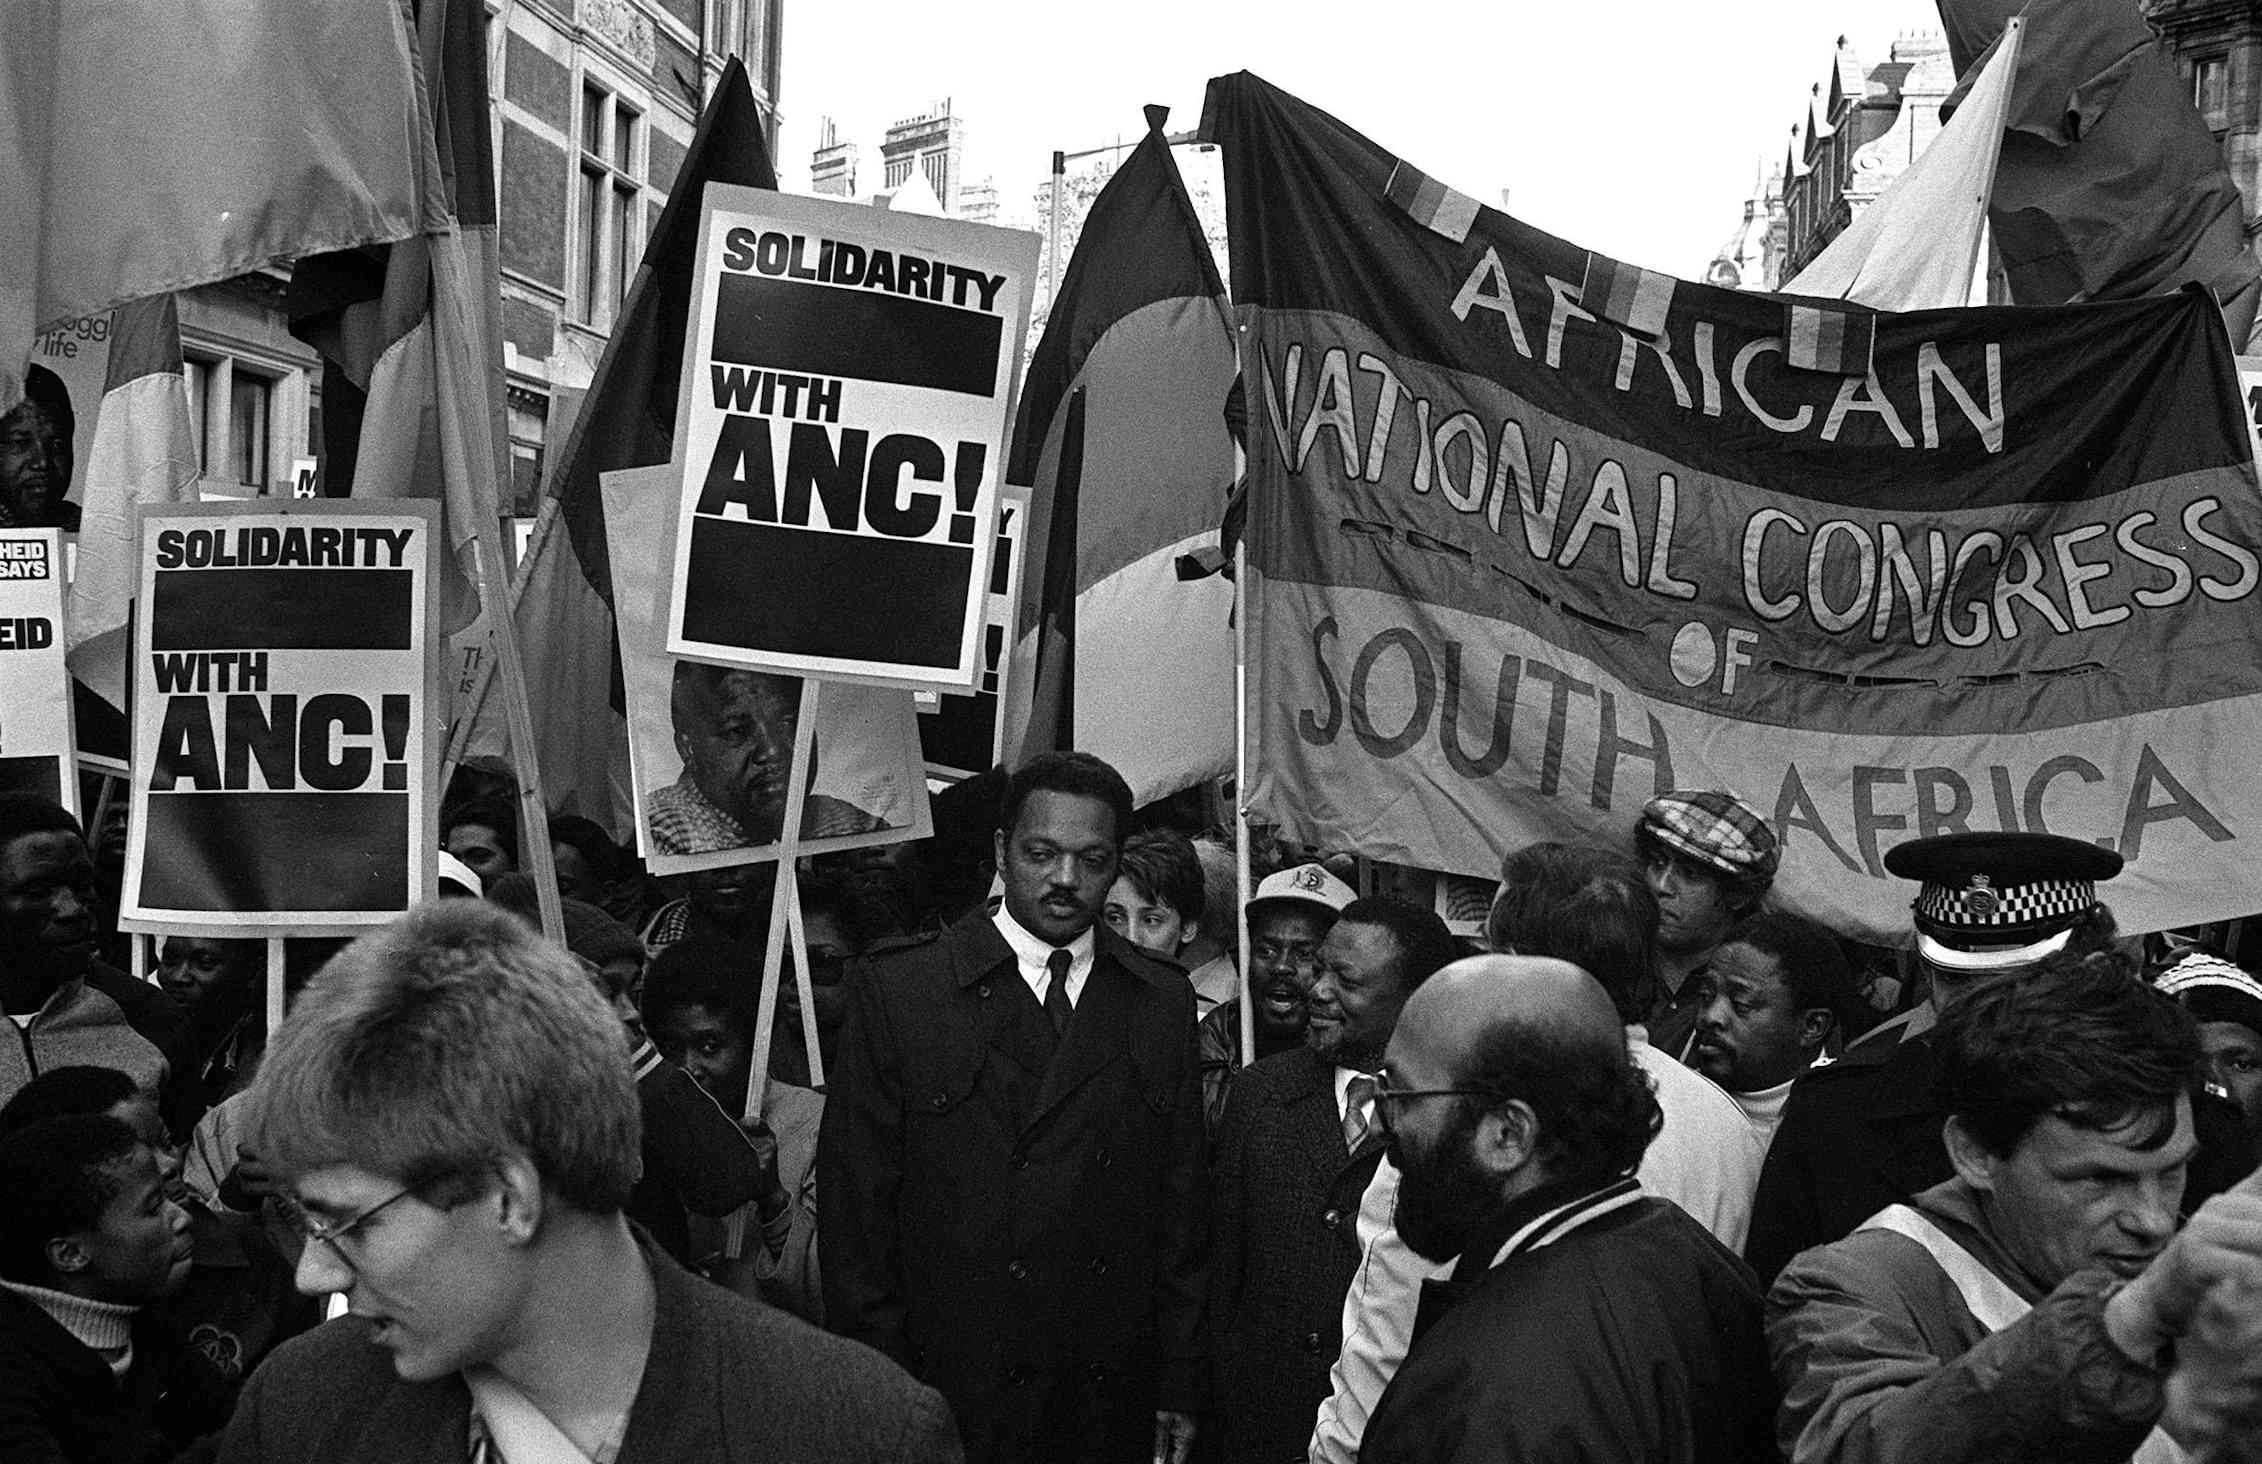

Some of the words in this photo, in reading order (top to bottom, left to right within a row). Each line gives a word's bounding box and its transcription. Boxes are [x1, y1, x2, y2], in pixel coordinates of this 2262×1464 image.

[723, 227, 1007, 312] SOLIDARITY
[43, 332, 78, 358] life
[1451, 246, 2003, 453] AFRICAN
[710, 364, 842, 424] WITH
[695, 414, 988, 545] ANC!
[156, 526, 414, 569] SOLIDARITY
[1741, 495, 2262, 649] CONGRESS
[151, 652, 269, 694] WITH
[1668, 621, 1761, 696] OF
[148, 693, 411, 792] ANC!
[1300, 616, 1677, 813] SOUTH
[1773, 742, 2237, 880] AFRICA
